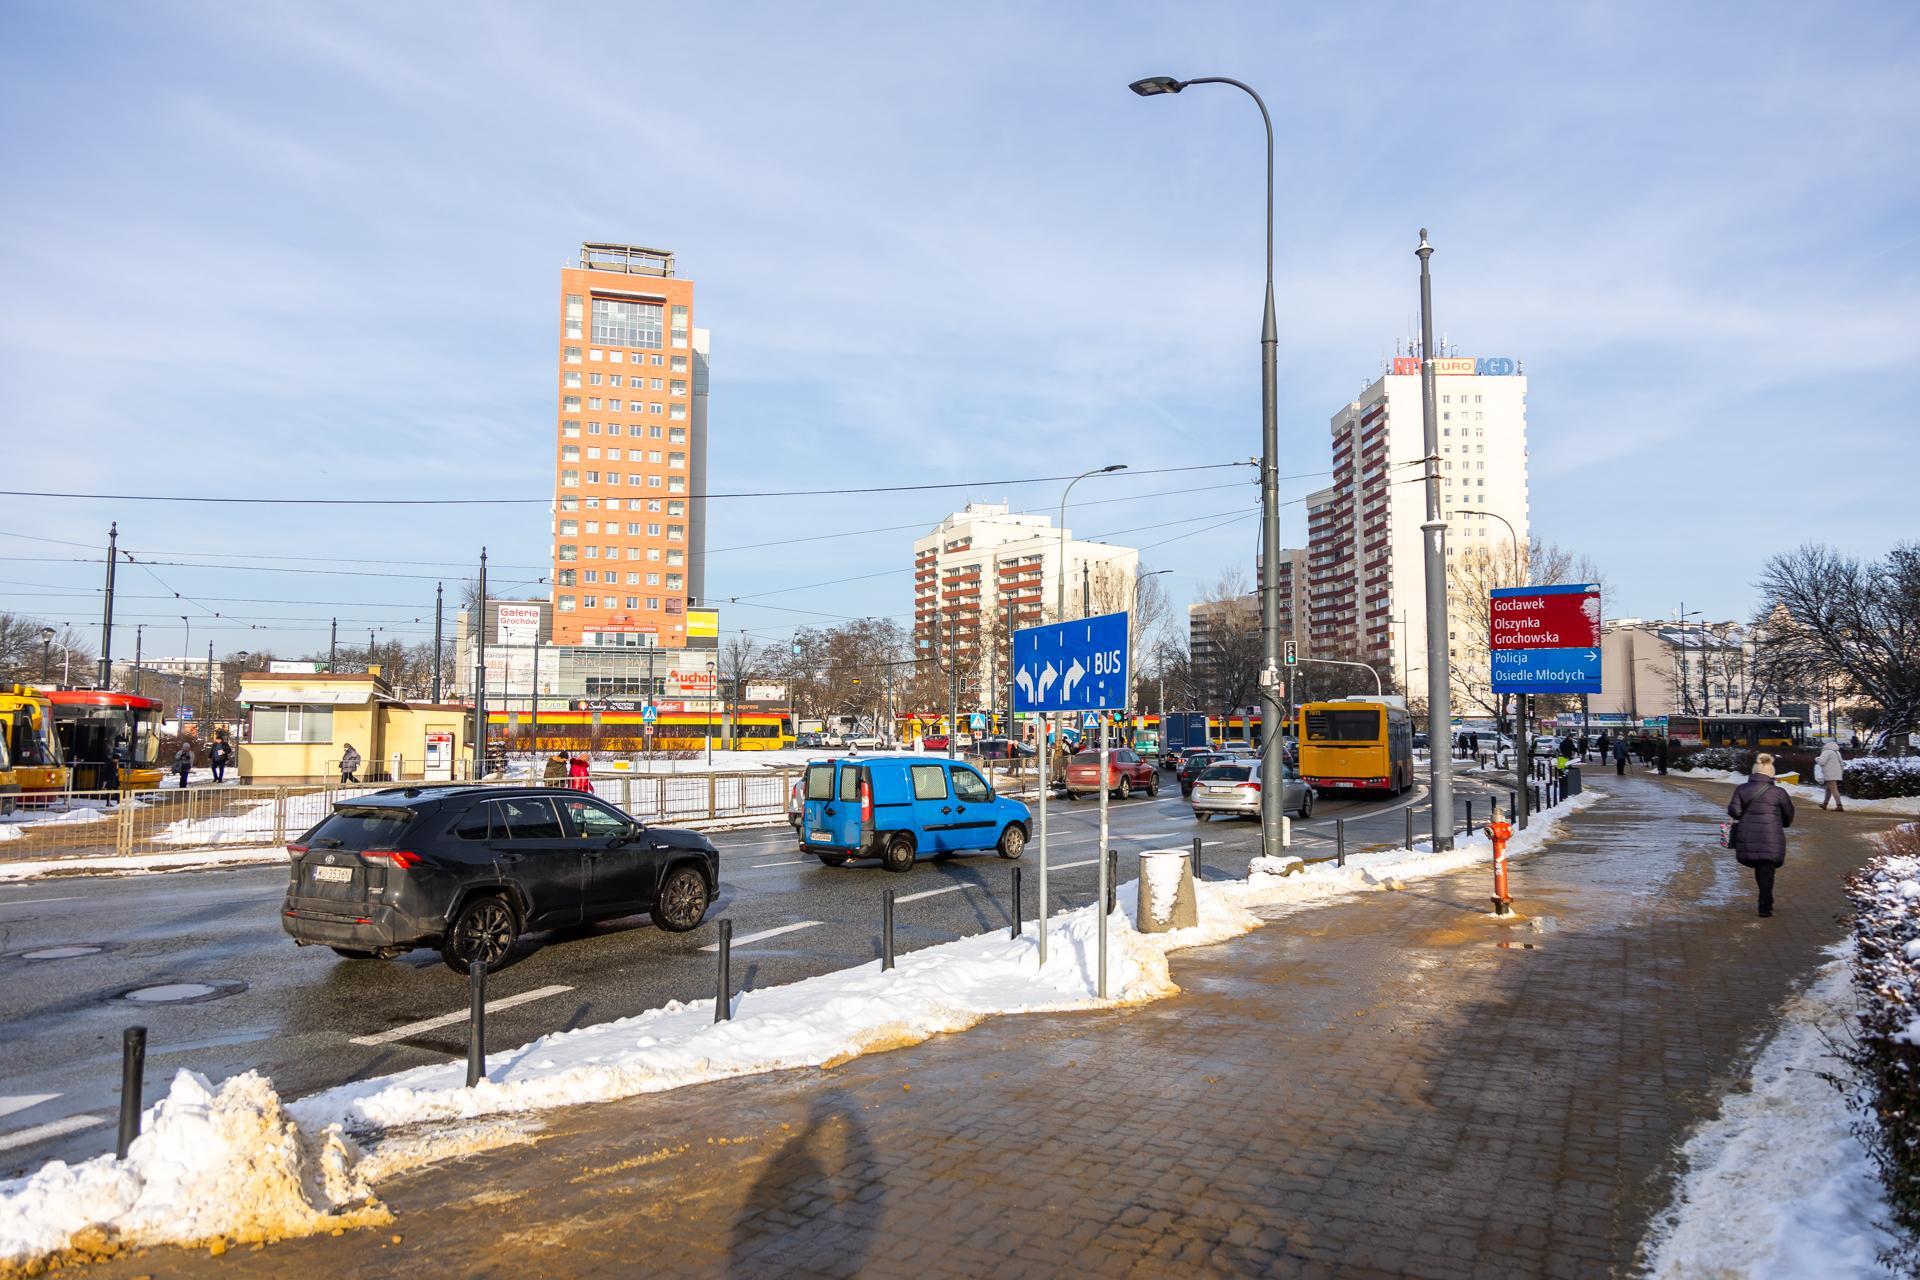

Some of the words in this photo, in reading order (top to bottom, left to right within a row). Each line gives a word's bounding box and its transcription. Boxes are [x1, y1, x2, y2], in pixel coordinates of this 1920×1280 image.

[1433, 362, 1472, 371] EURO
[1475, 358, 1514, 376] AGD
[1494, 598, 1545, 611] Gocławek
[500, 607, 539, 617] Galeria
[500, 616, 538, 625] Grochów
[1494, 617, 1540, 631] Olszynka
[1494, 631, 1559, 644] Grochowska
[1094, 650, 1121, 675] BUS
[1495, 652, 1528, 665] Policja
[668, 670, 716, 682] Auchan
[1495, 670, 1533, 681] Osiedle
[1536, 669, 1585, 683] Młodych
